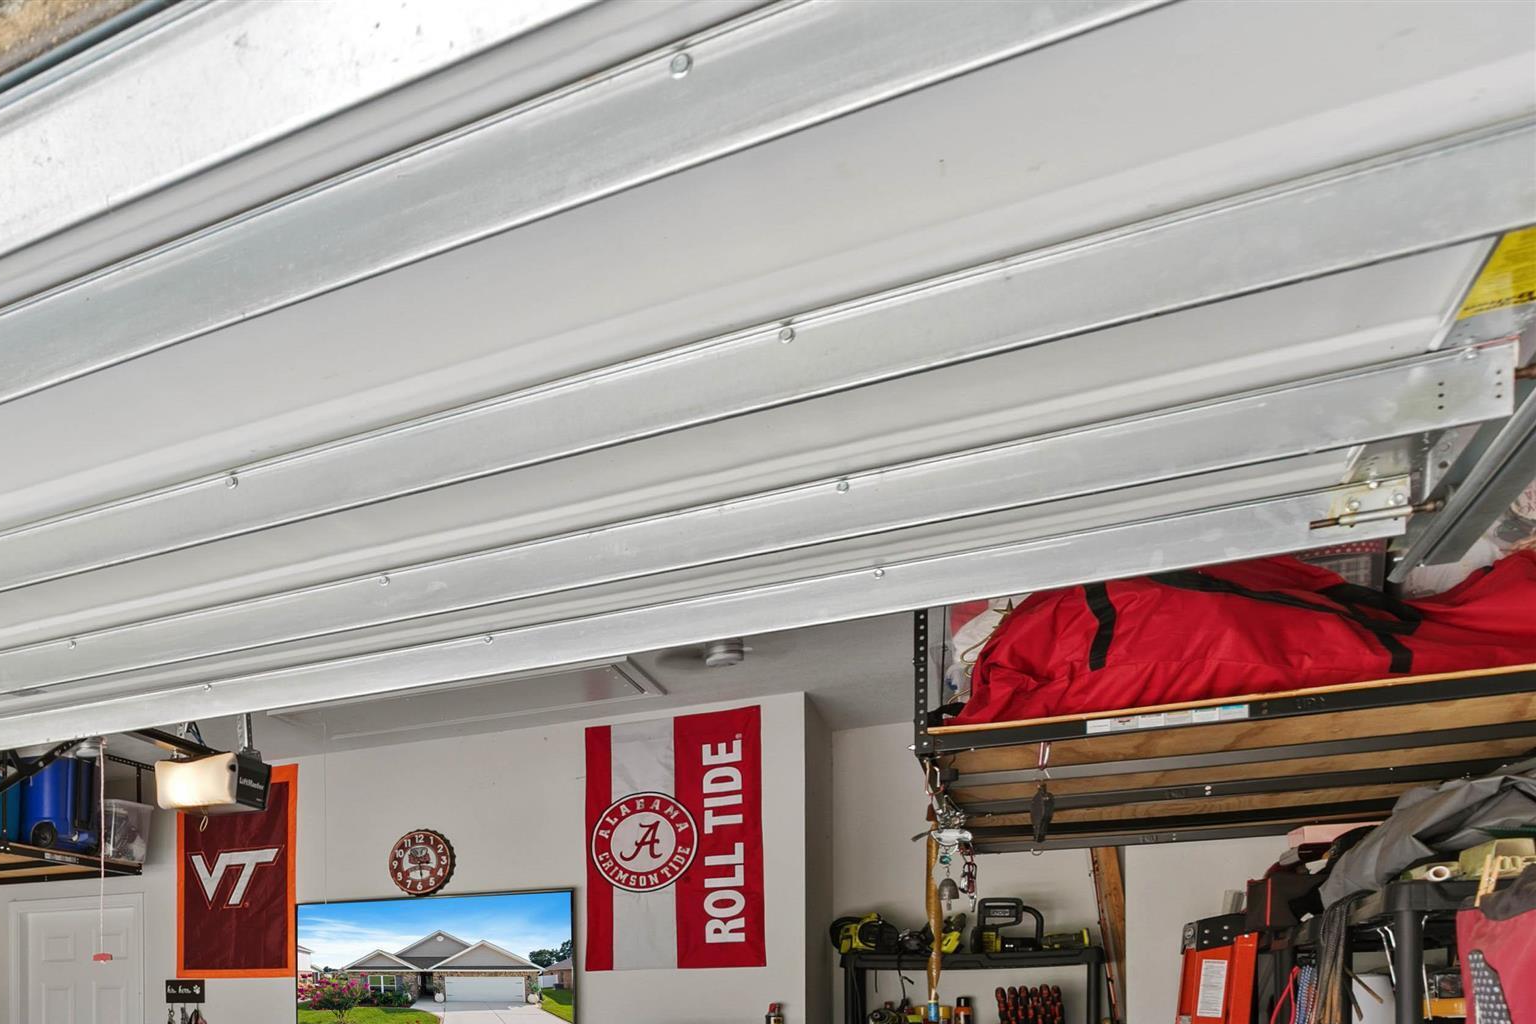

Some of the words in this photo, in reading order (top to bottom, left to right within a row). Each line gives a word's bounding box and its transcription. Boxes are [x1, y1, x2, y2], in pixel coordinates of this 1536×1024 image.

[598, 798, 689, 839] ALABAMA
[404, 839, 411, 847] 11
[415, 834, 424, 843] 12
[429, 836, 434, 845] 1
[620, 820, 663, 861] A
[437, 844, 444, 853] 2
[395, 849, 404, 858] 10
[392, 860, 398, 869] 9
[440, 856, 447, 865] 3
[598, 851, 660, 887] CRIMSON
[661, 845, 691, 878] TIDE
[189, 846, 282, 907] VT
[397, 872, 403, 881] 8
[437, 868, 443, 876] 4
[406, 880, 412, 888] 7
[416, 881, 423, 890] 6
[429, 877, 435, 886] 5
[703, 842, 746, 944] ROLL
